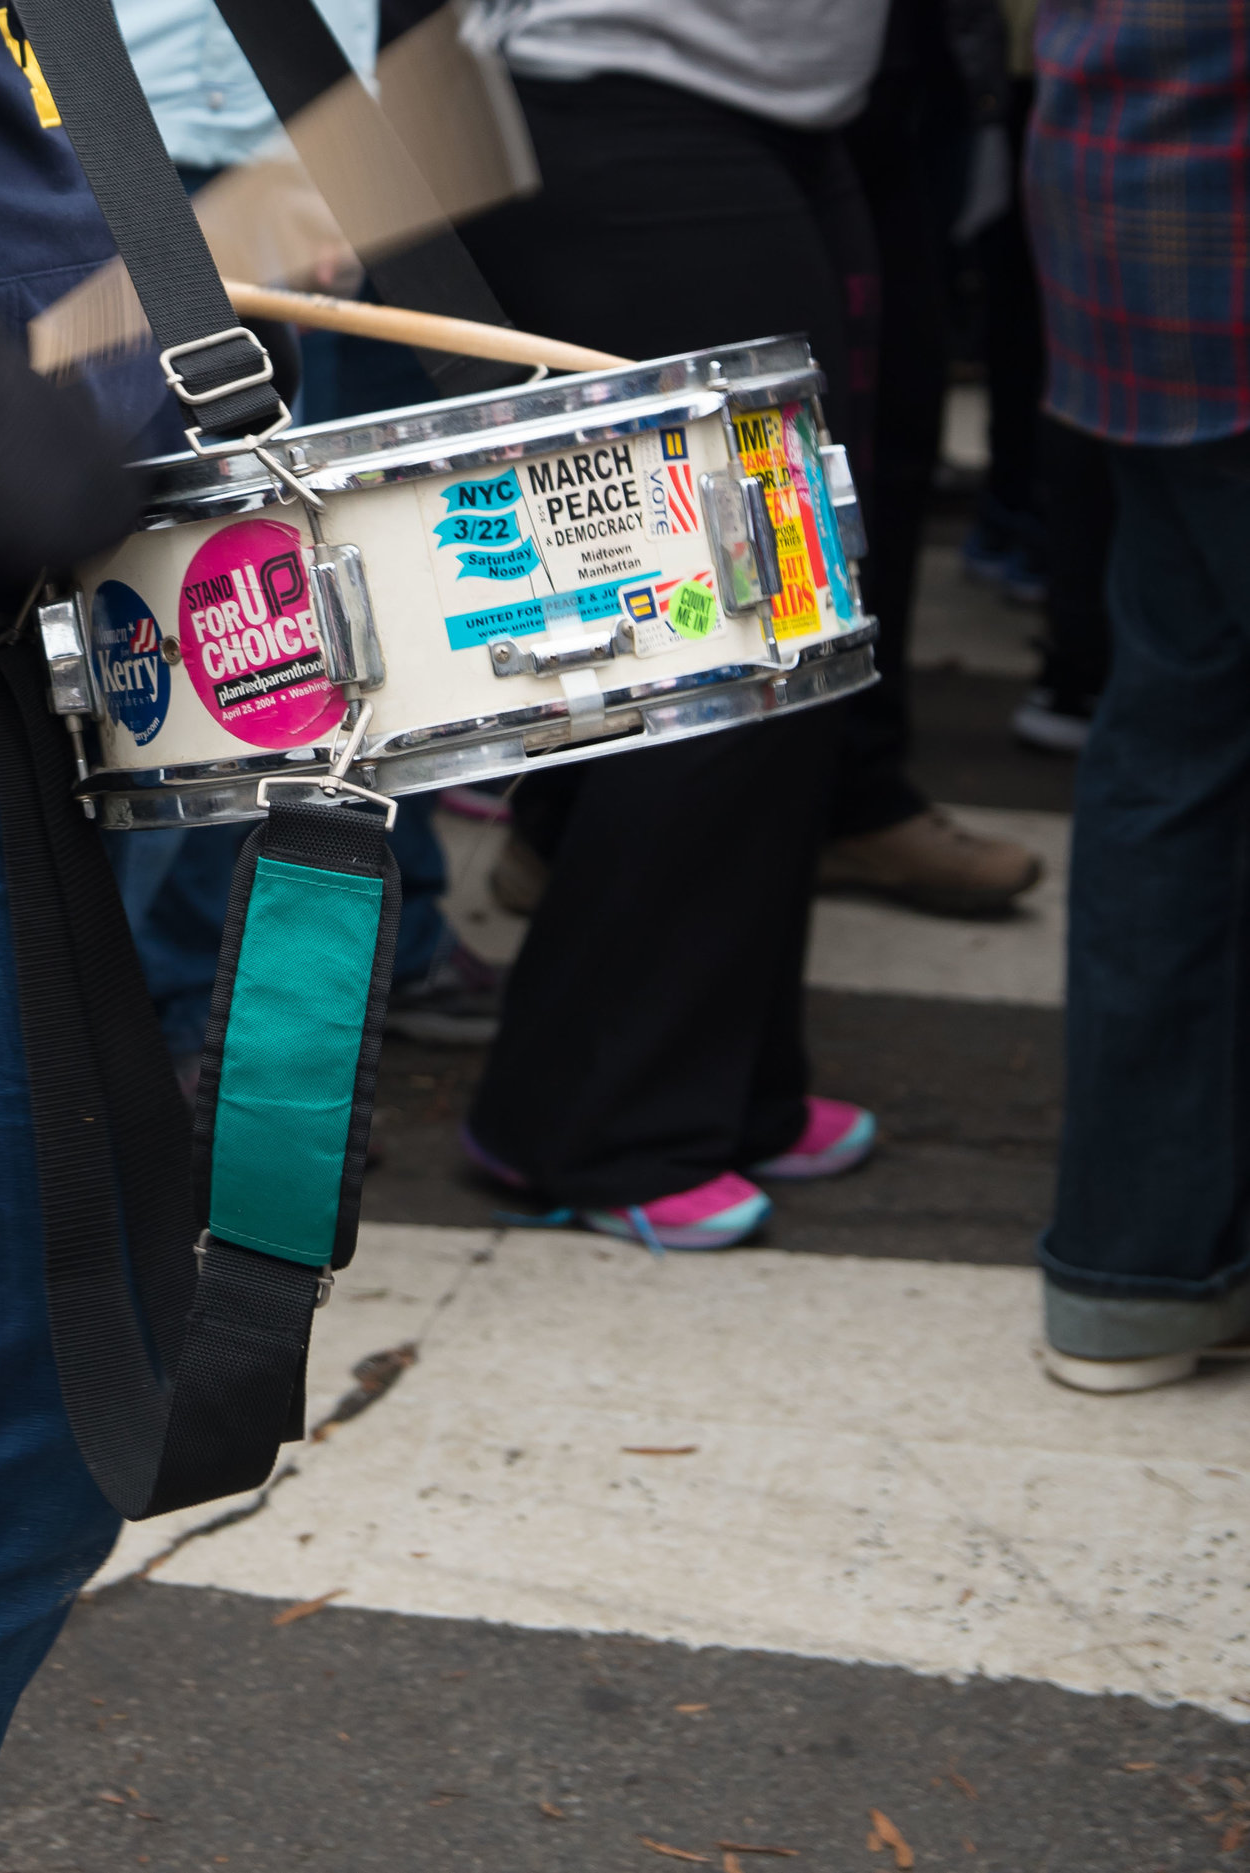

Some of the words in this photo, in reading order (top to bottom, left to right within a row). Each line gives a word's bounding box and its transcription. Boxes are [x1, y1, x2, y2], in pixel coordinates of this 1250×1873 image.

[527, 444, 634, 495] MARCH
[458, 480, 515, 506] NYC
[546, 480, 641, 525] PEACE
[649, 467, 670, 535] VOTE
[453, 518, 510, 541] 3/22
[554, 512, 644, 547] DEMOCRACY
[468, 547, 532, 566] Saturday
[577, 558, 642, 580] Manhattan
[580, 544, 633, 564] Midtown
[488, 565, 526, 579] Noon
[184, 574, 233, 611] STAND
[680, 587, 714, 616] COUNT
[191, 600, 246, 643] FOR
[465, 611, 514, 629] UNITED
[517, 604, 543, 619] FOR
[545, 596, 583, 612] PEACE
[589, 591, 598, 602] &
[675, 606, 691, 629] ME
[202, 609, 319, 679] CHOICE
[97, 650, 159, 703] Kerry
[221, 705, 242, 722] April
[256, 696, 277, 711] 2004
